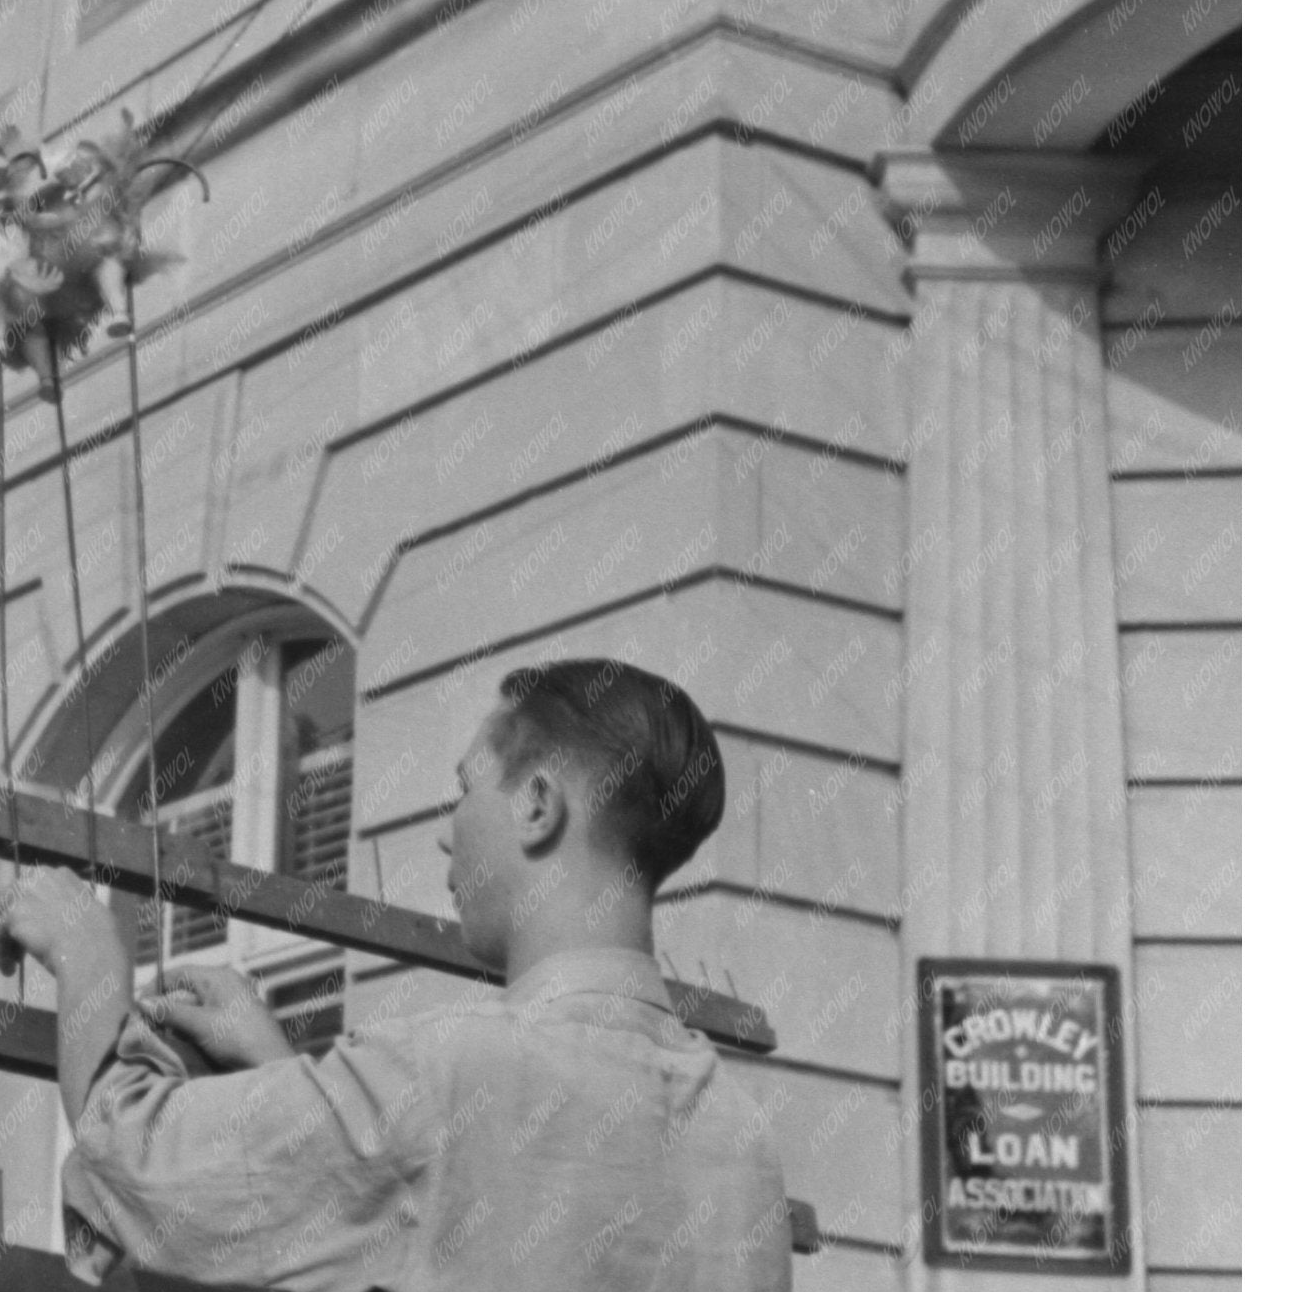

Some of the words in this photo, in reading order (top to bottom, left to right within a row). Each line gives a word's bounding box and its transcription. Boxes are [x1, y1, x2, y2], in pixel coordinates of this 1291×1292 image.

[944, 1008, 1100, 1060] CROWLEY
[946, 1060, 1096, 1093] BUILDING
[968, 1132, 1079, 1170] LOAN
